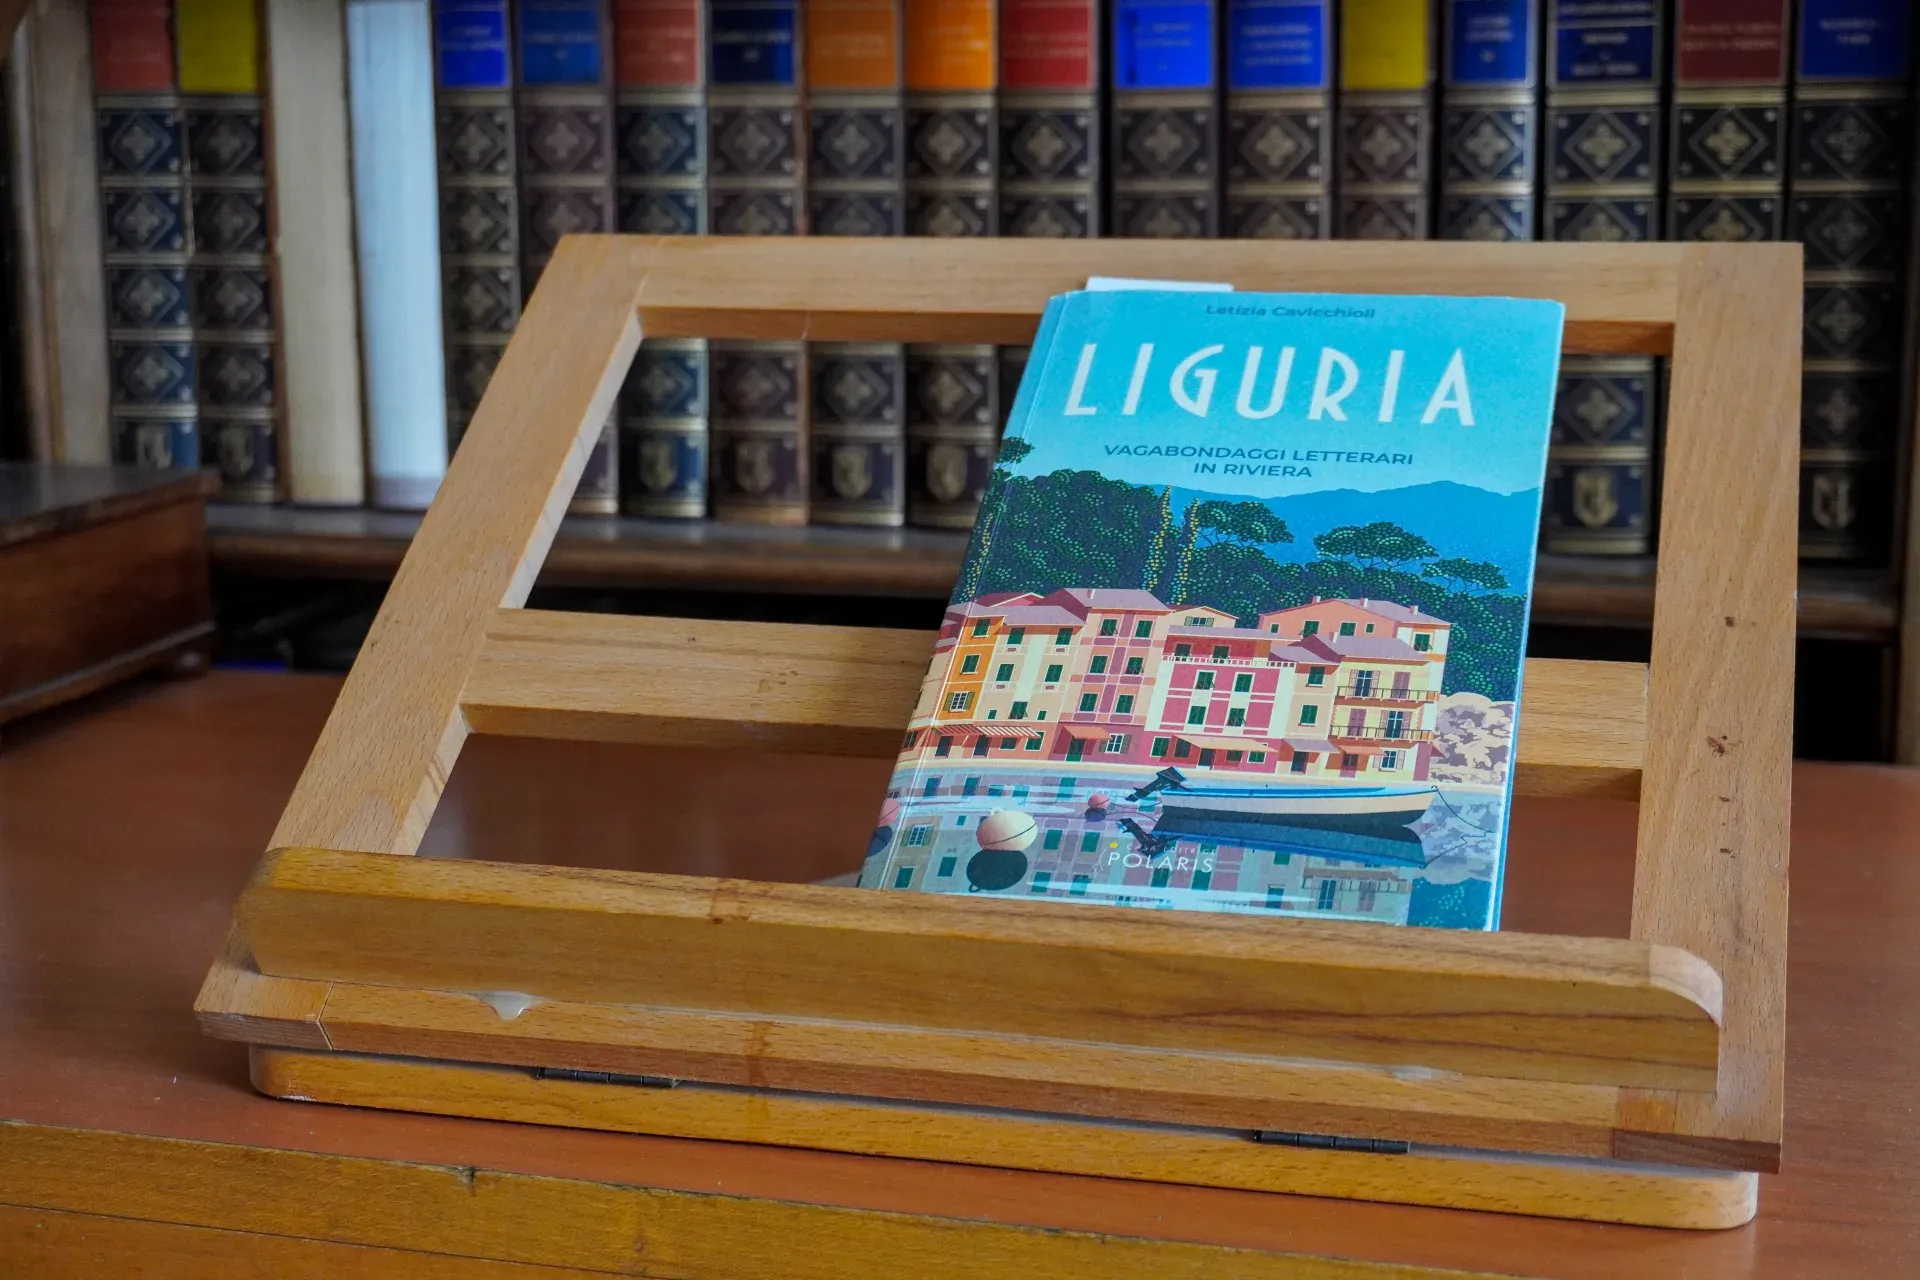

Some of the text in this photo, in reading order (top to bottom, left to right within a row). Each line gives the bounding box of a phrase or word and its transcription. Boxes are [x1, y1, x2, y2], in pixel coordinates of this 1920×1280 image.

[1206, 305, 1376, 318] Letizia Cavicchioli
[1064, 343, 1476, 426] LIGURIA
[1105, 445, 1413, 465] VAGABONDAGGI LETTERARI
[1193, 463, 1312, 477] IN RIVIERA
[1108, 852, 1213, 873] POLARIS
